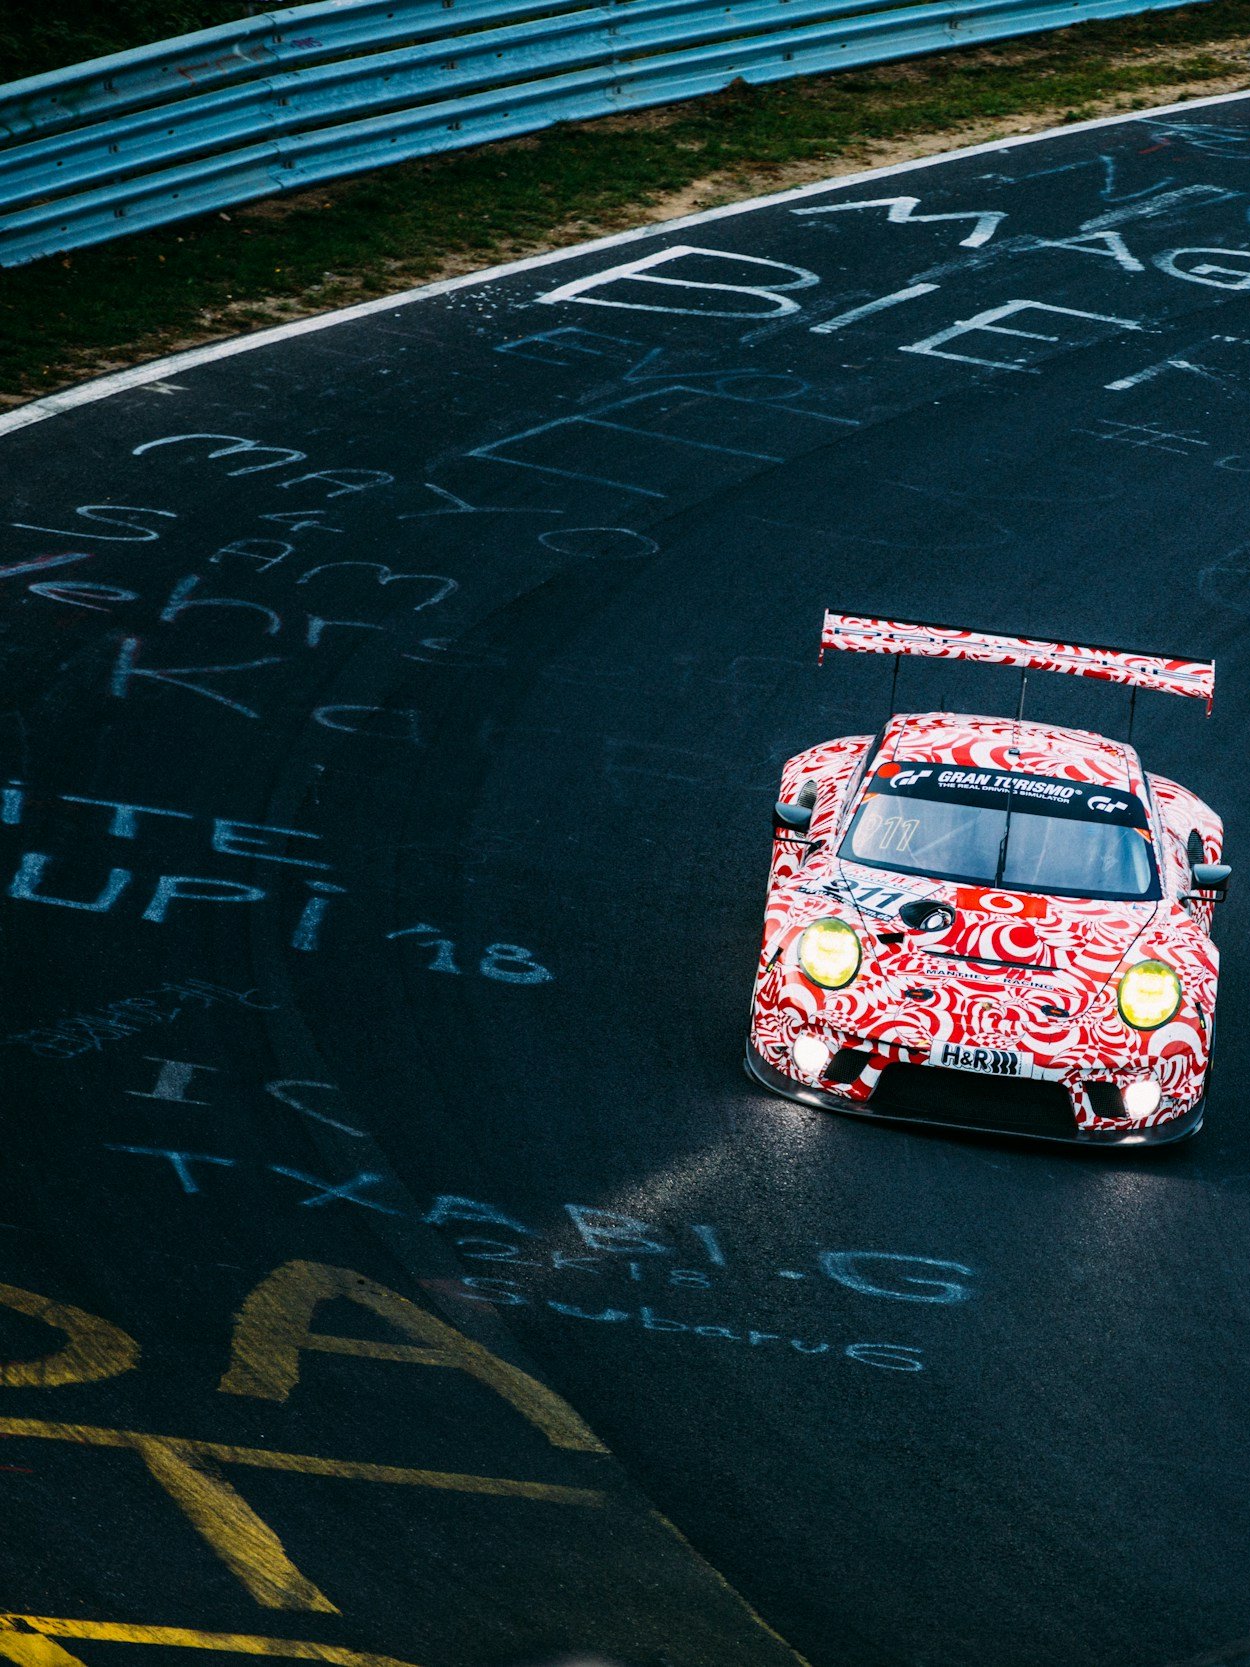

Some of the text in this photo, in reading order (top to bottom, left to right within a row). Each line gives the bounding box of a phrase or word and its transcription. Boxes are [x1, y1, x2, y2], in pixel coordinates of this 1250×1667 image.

[937, 771, 992, 786] GRAN
[1019, 790, 1070, 804] SIMULATOR
[822, 879, 906, 909] 911
[926, 969, 990, 980] MANTHEY
[1003, 978, 1054, 991] RACING
[941, 1043, 991, 1071] H&R
